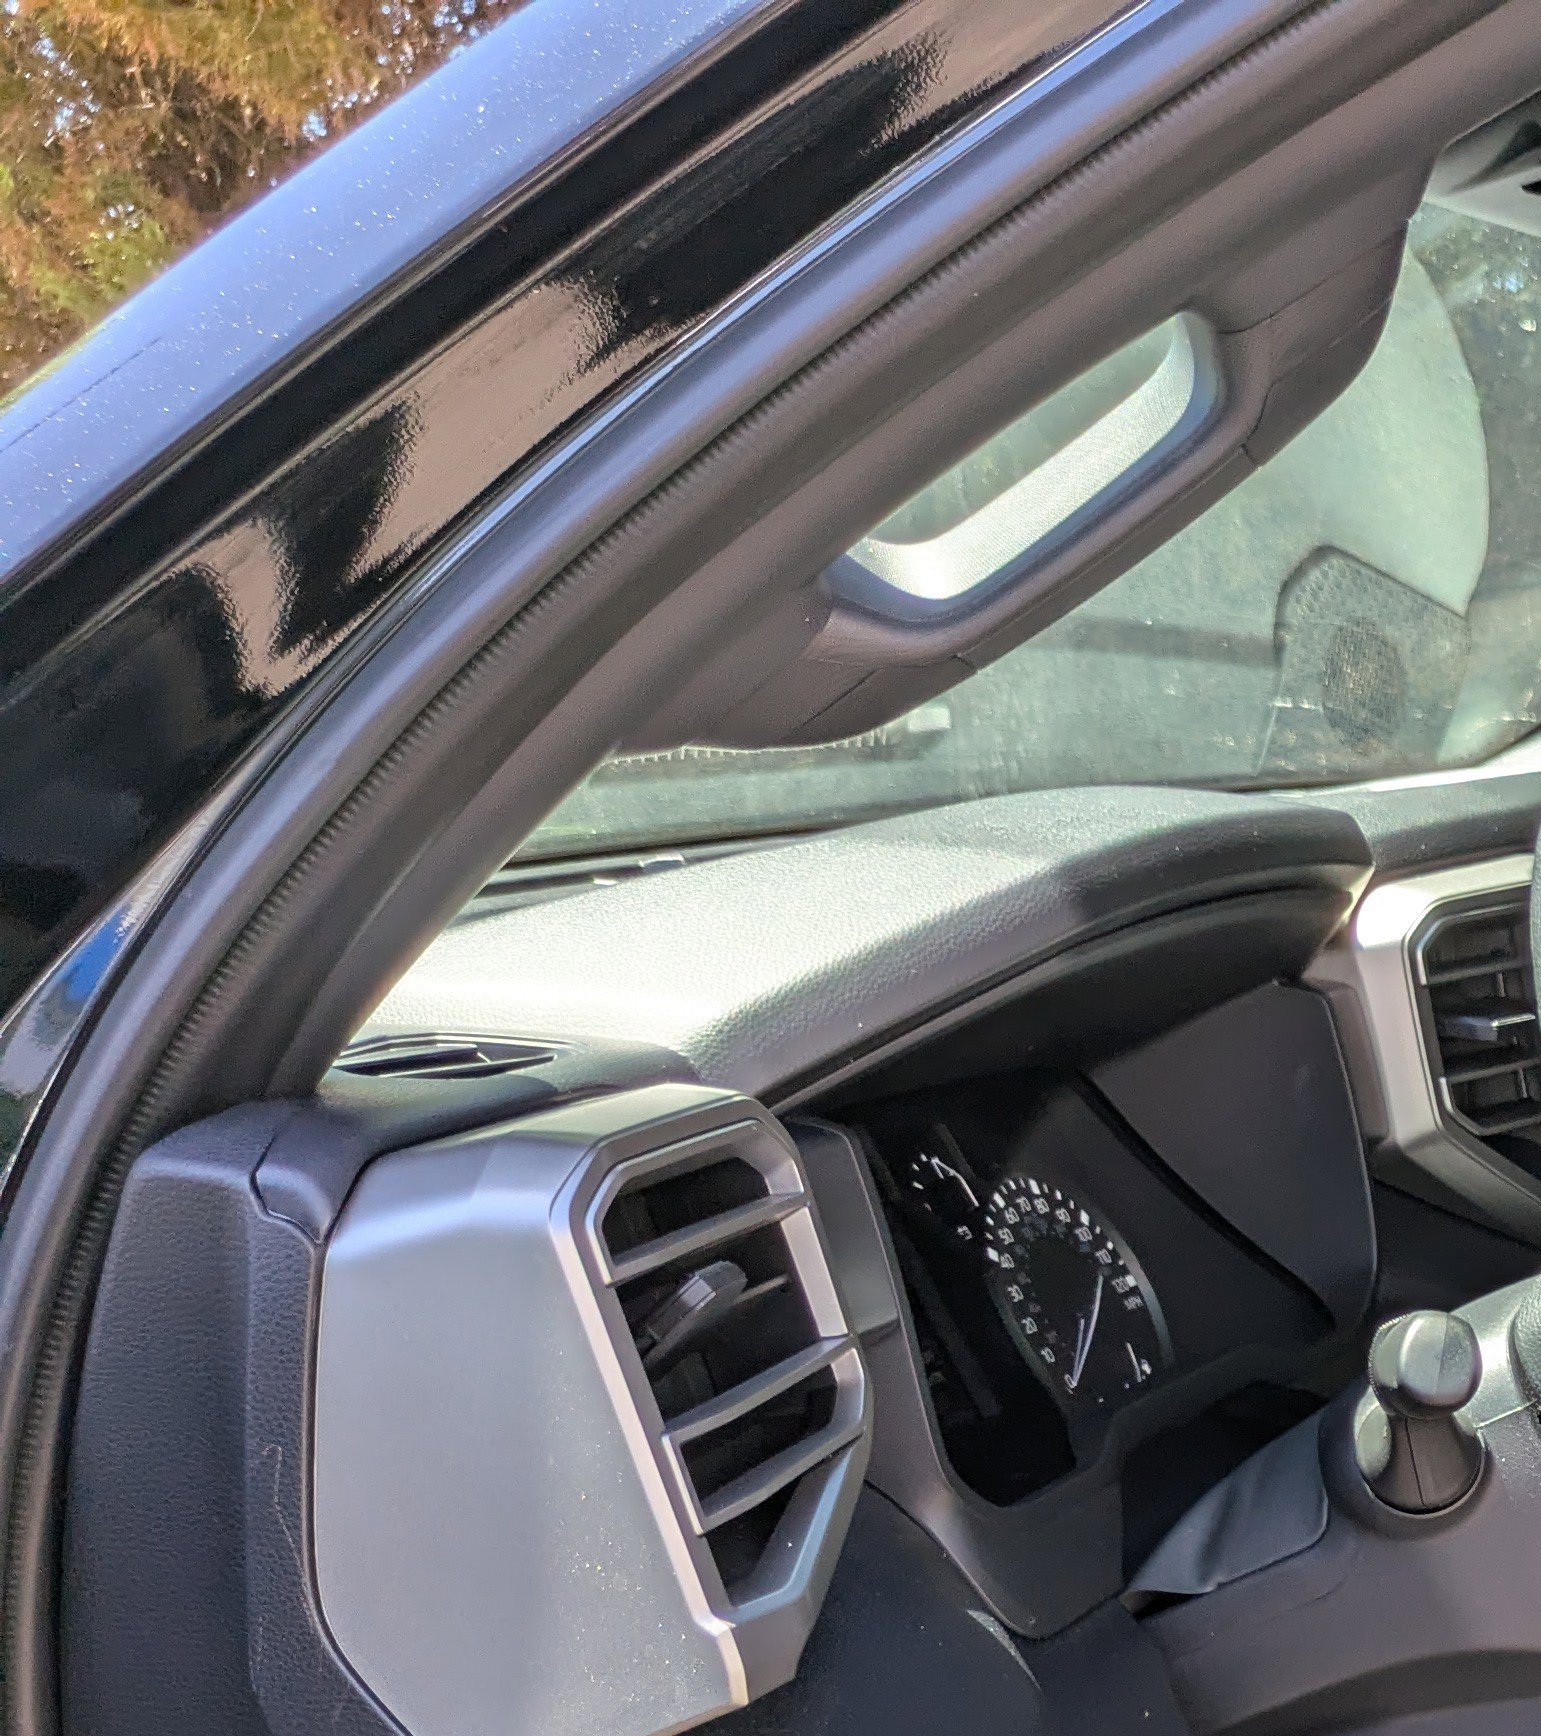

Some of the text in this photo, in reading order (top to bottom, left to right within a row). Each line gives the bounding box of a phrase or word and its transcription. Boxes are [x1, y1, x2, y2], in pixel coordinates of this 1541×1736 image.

[1016, 1196, 1031, 1212] 70
[1034, 1198, 1050, 1214] 80
[1005, 1207, 1020, 1224] 60
[1055, 1208, 1071, 1223] 90
[998, 1228, 1014, 1245] 50
[1074, 1226, 1092, 1242] 100
[1000, 1252, 1015, 1269] 40
[1007, 1285, 1024, 1302] 30
[1112, 1276, 1130, 1294] 120
[1021, 1317, 1038, 1334] 20
[1041, 1347, 1055, 1363] 10
